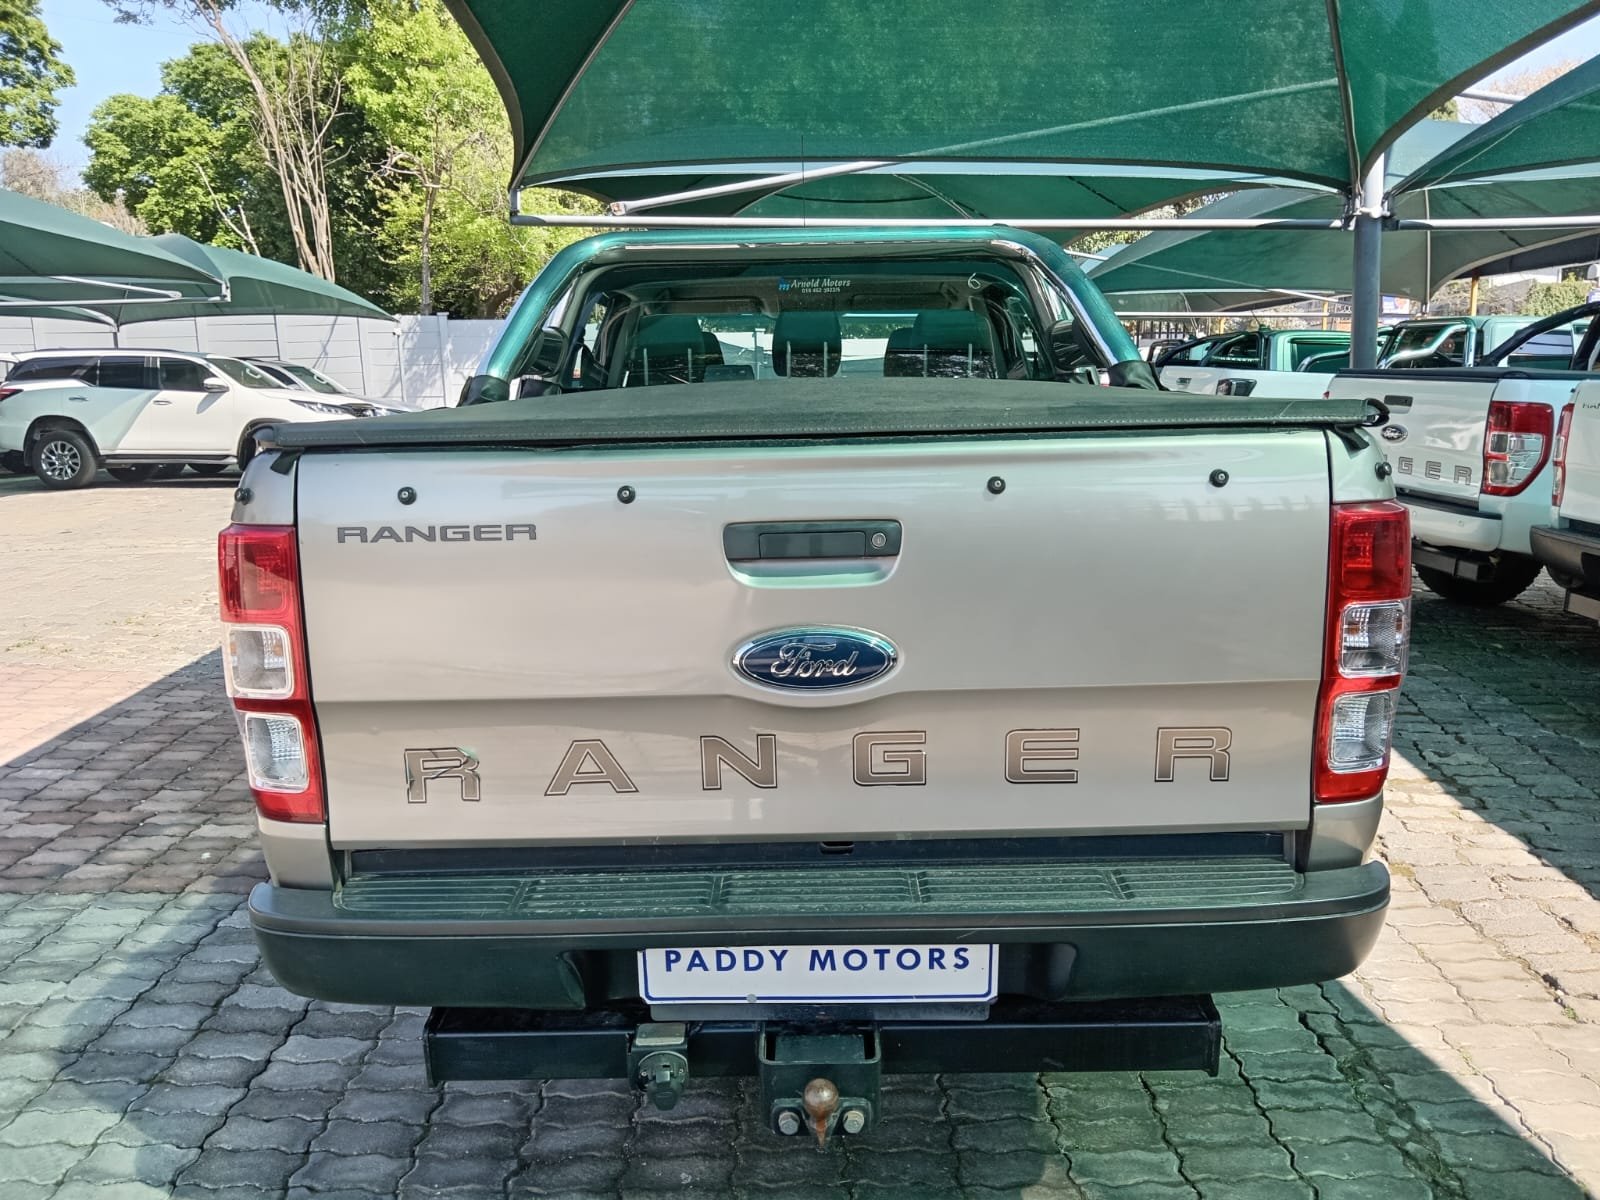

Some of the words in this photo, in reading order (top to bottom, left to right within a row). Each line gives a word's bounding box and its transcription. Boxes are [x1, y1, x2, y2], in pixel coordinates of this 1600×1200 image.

[791, 279, 820, 288] Arnold
[821, 279, 851, 288] Motors
[337, 524, 537, 543] RANGER
[770, 642, 860, 678] Ford
[404, 726, 1233, 803] RANGER
[665, 949, 788, 972] PADDY
[808, 947, 970, 972] MOTORS
